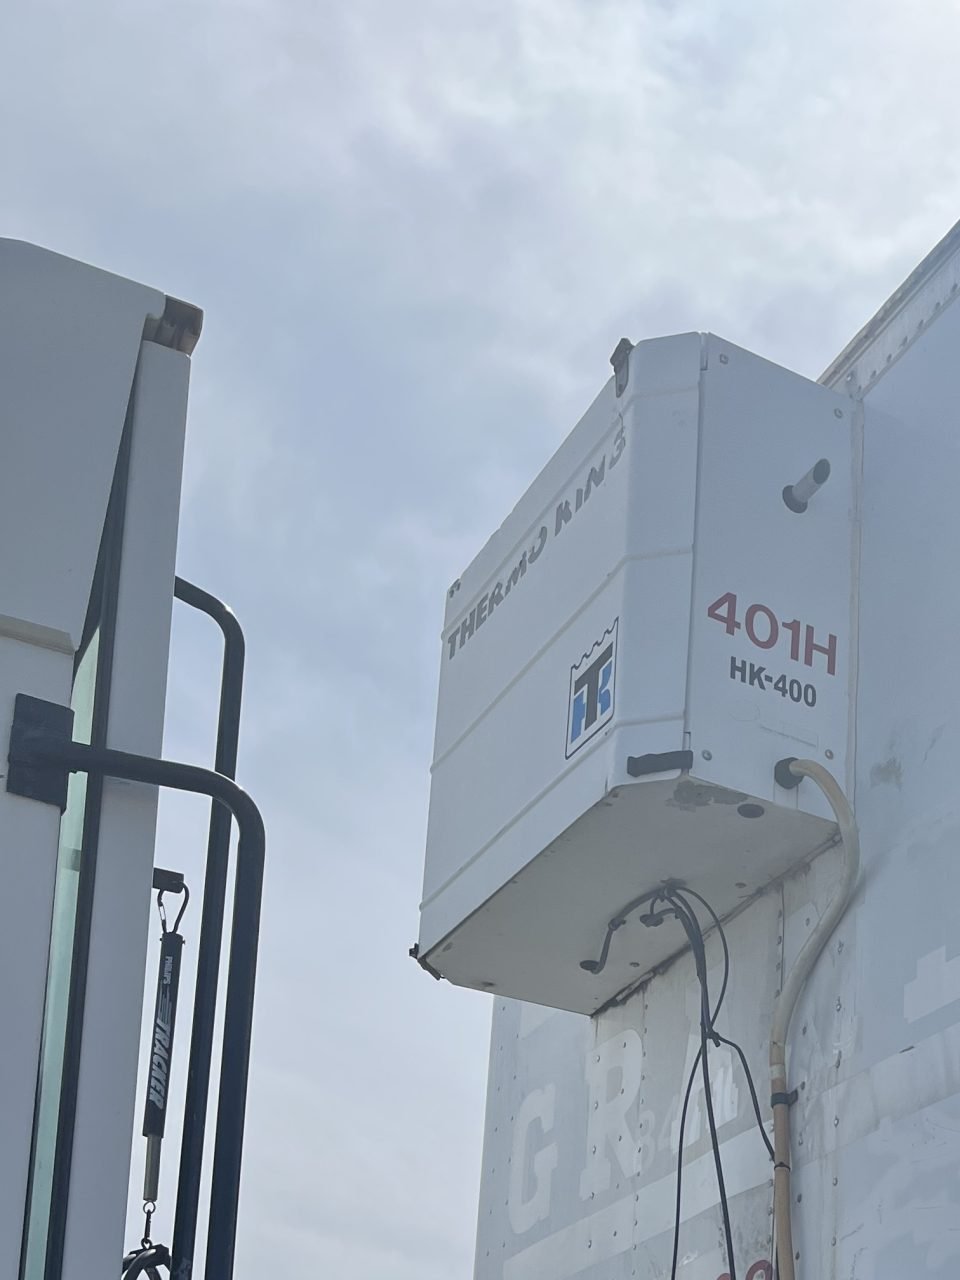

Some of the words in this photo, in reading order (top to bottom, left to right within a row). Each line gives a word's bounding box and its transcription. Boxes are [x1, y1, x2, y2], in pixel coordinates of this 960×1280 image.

[448, 526, 548, 661] THERMO
[708, 592, 837, 677] 401H
[730, 656, 817, 708] HK-400
[149, 1017, 171, 1110] TRACKER
